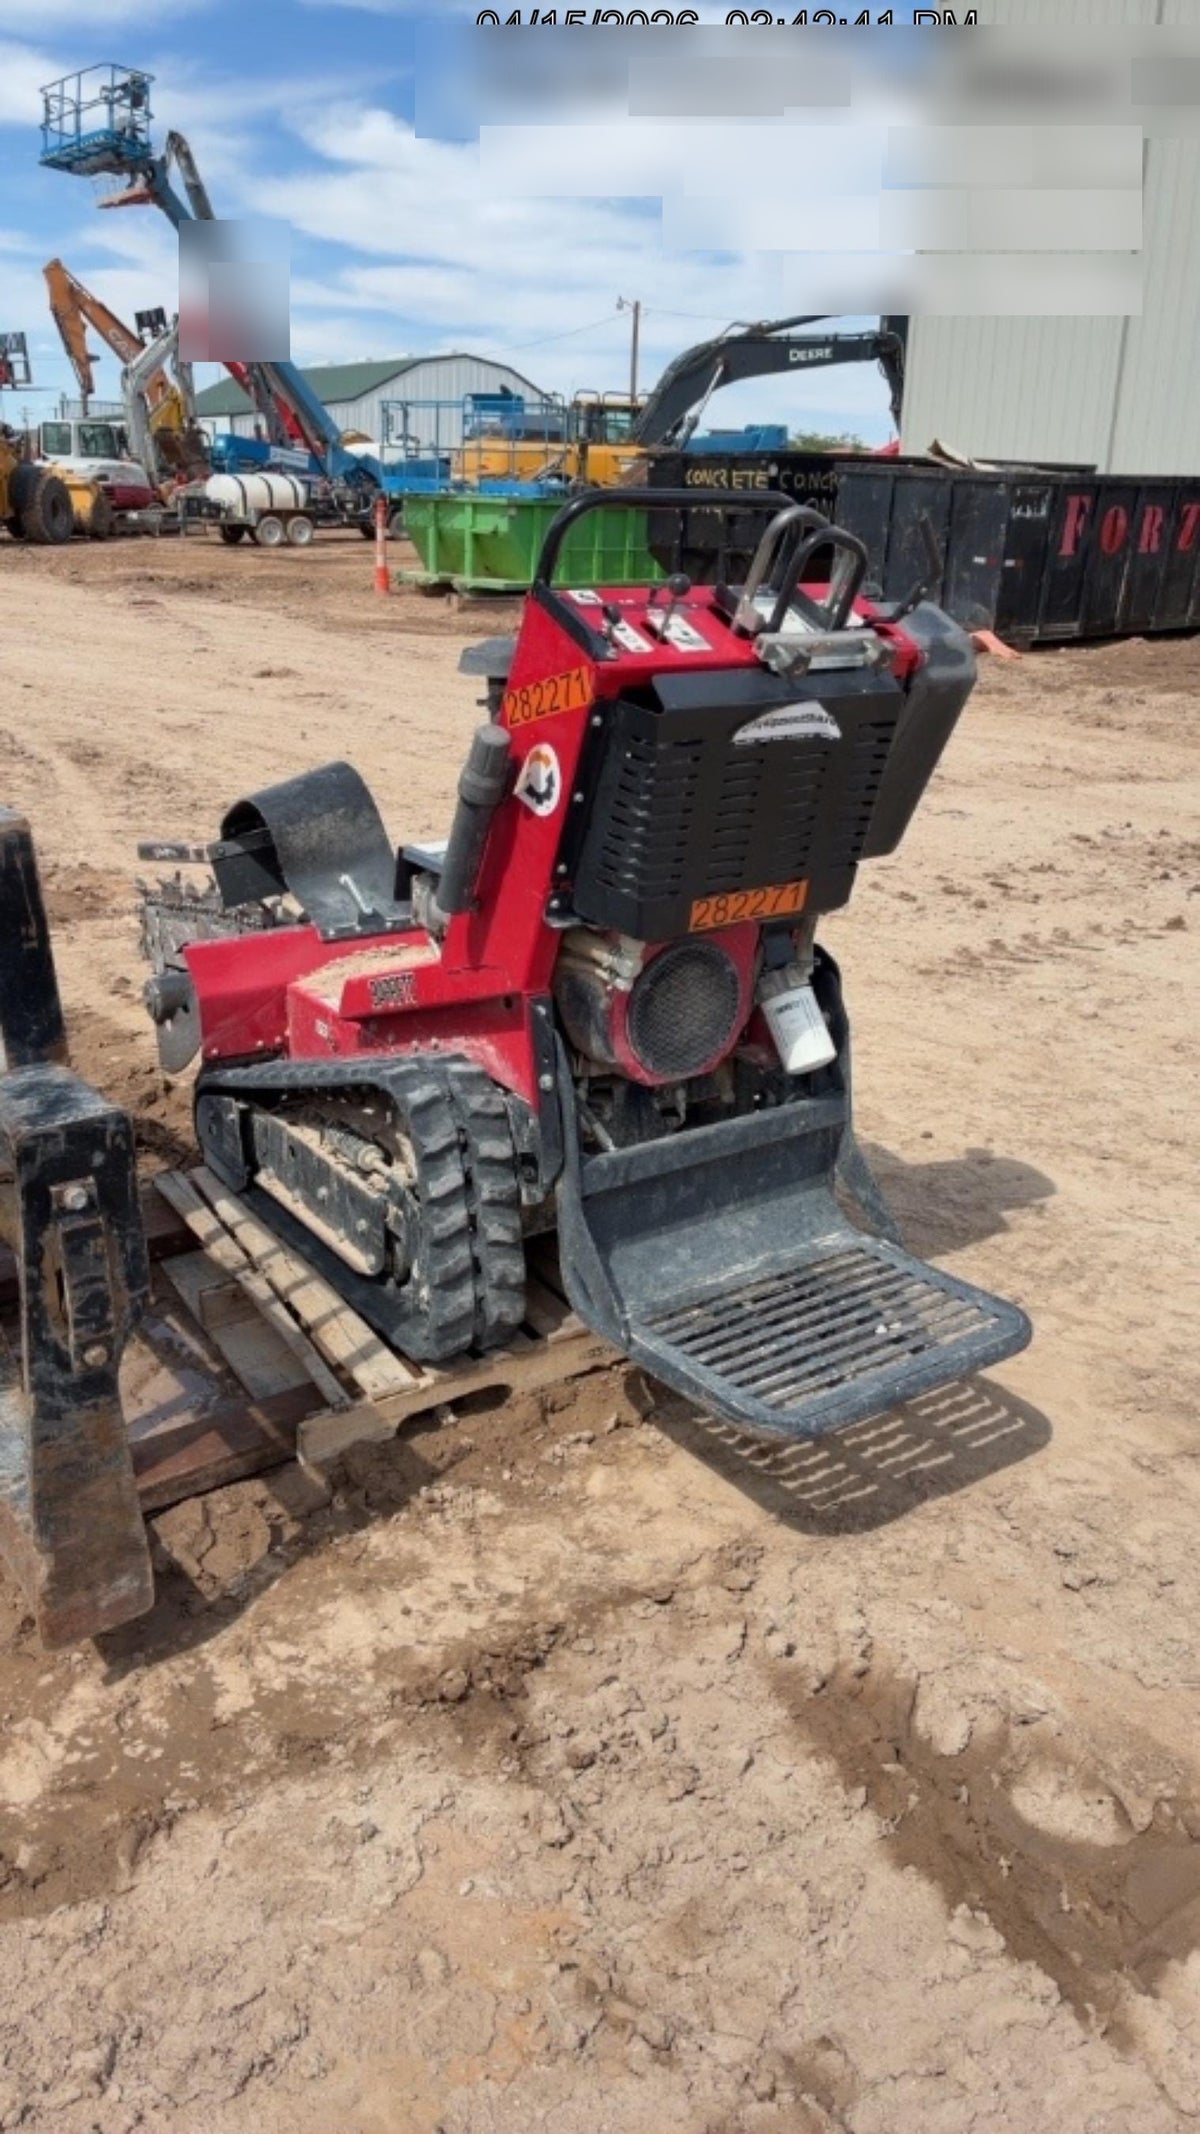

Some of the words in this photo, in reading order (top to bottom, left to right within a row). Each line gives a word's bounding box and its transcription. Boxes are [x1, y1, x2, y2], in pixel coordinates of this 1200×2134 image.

[789, 348, 833, 361] DEERE
[685, 468, 768, 489] CONCRETE
[507, 671, 587, 725] 282271
[693, 883, 801, 927] 282271
